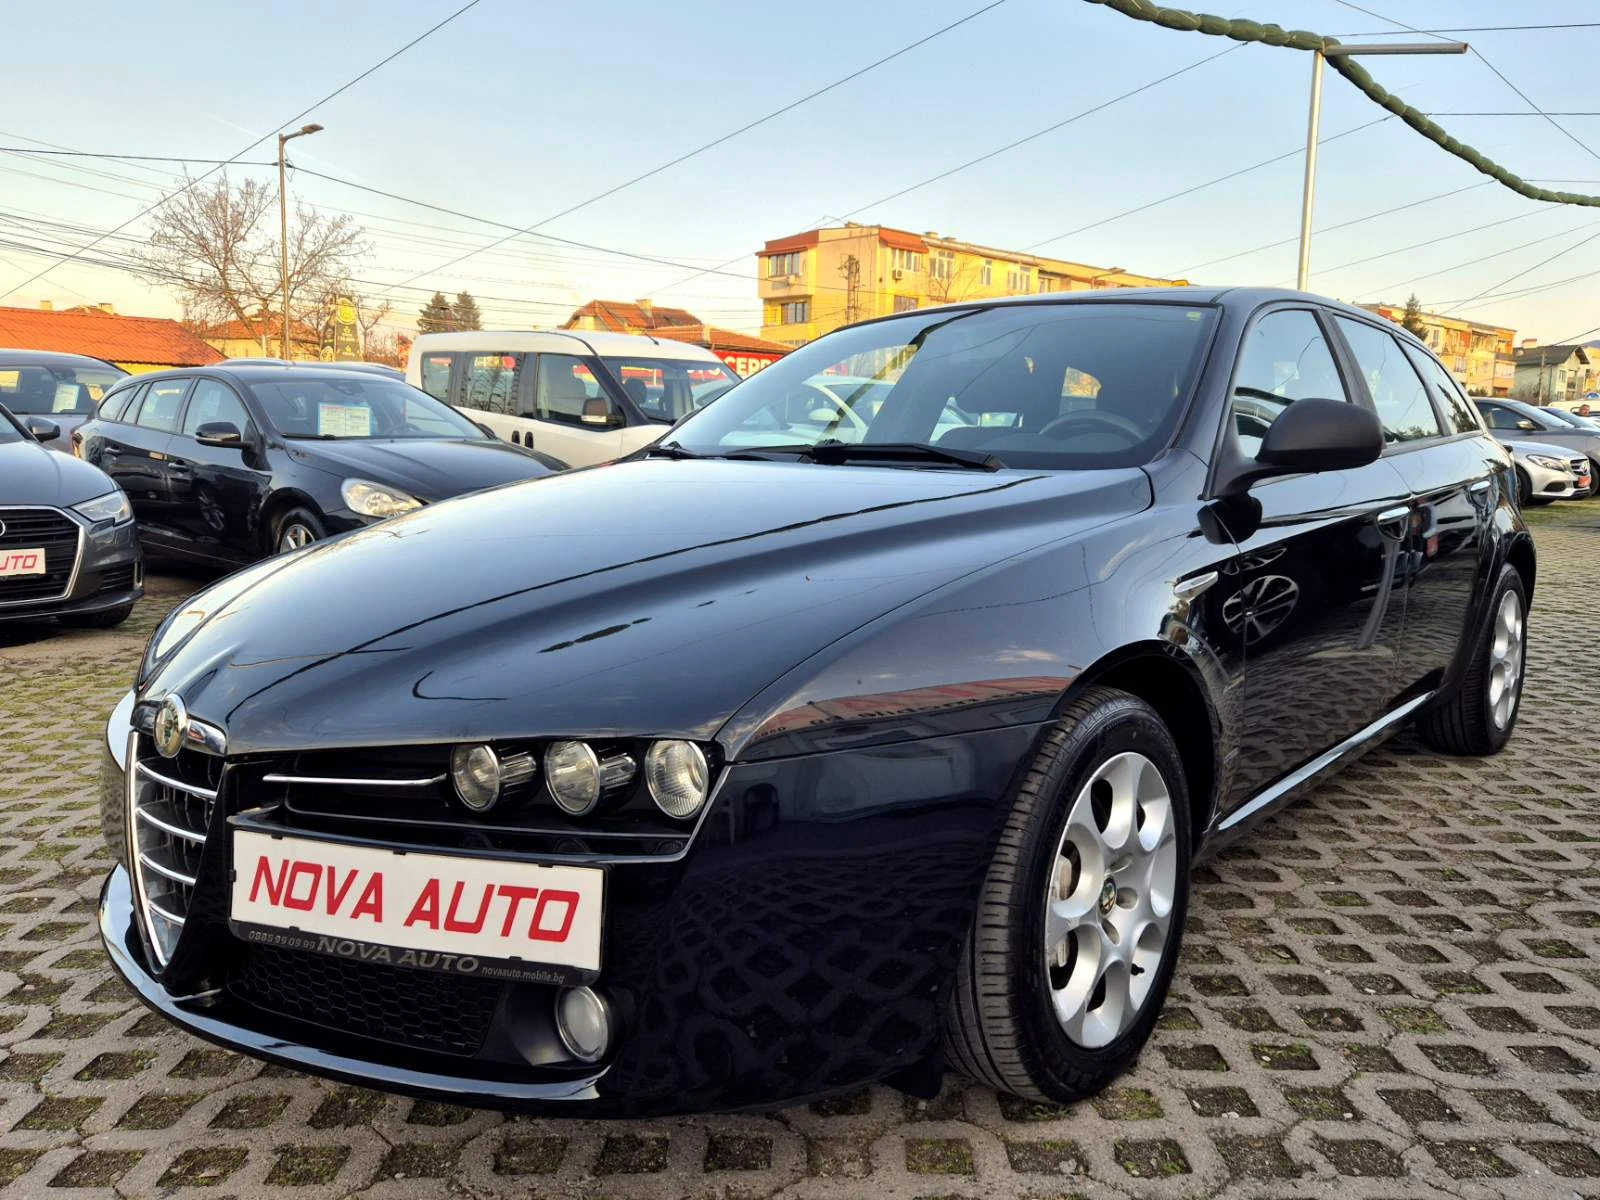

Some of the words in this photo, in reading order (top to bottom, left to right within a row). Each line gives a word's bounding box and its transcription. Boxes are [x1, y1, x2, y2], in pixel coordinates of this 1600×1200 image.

[248, 855, 383, 923] NOVA
[404, 878, 580, 943] AUTO
[316, 936, 391, 963] NOVA
[397, 950, 479, 973] AUTO
